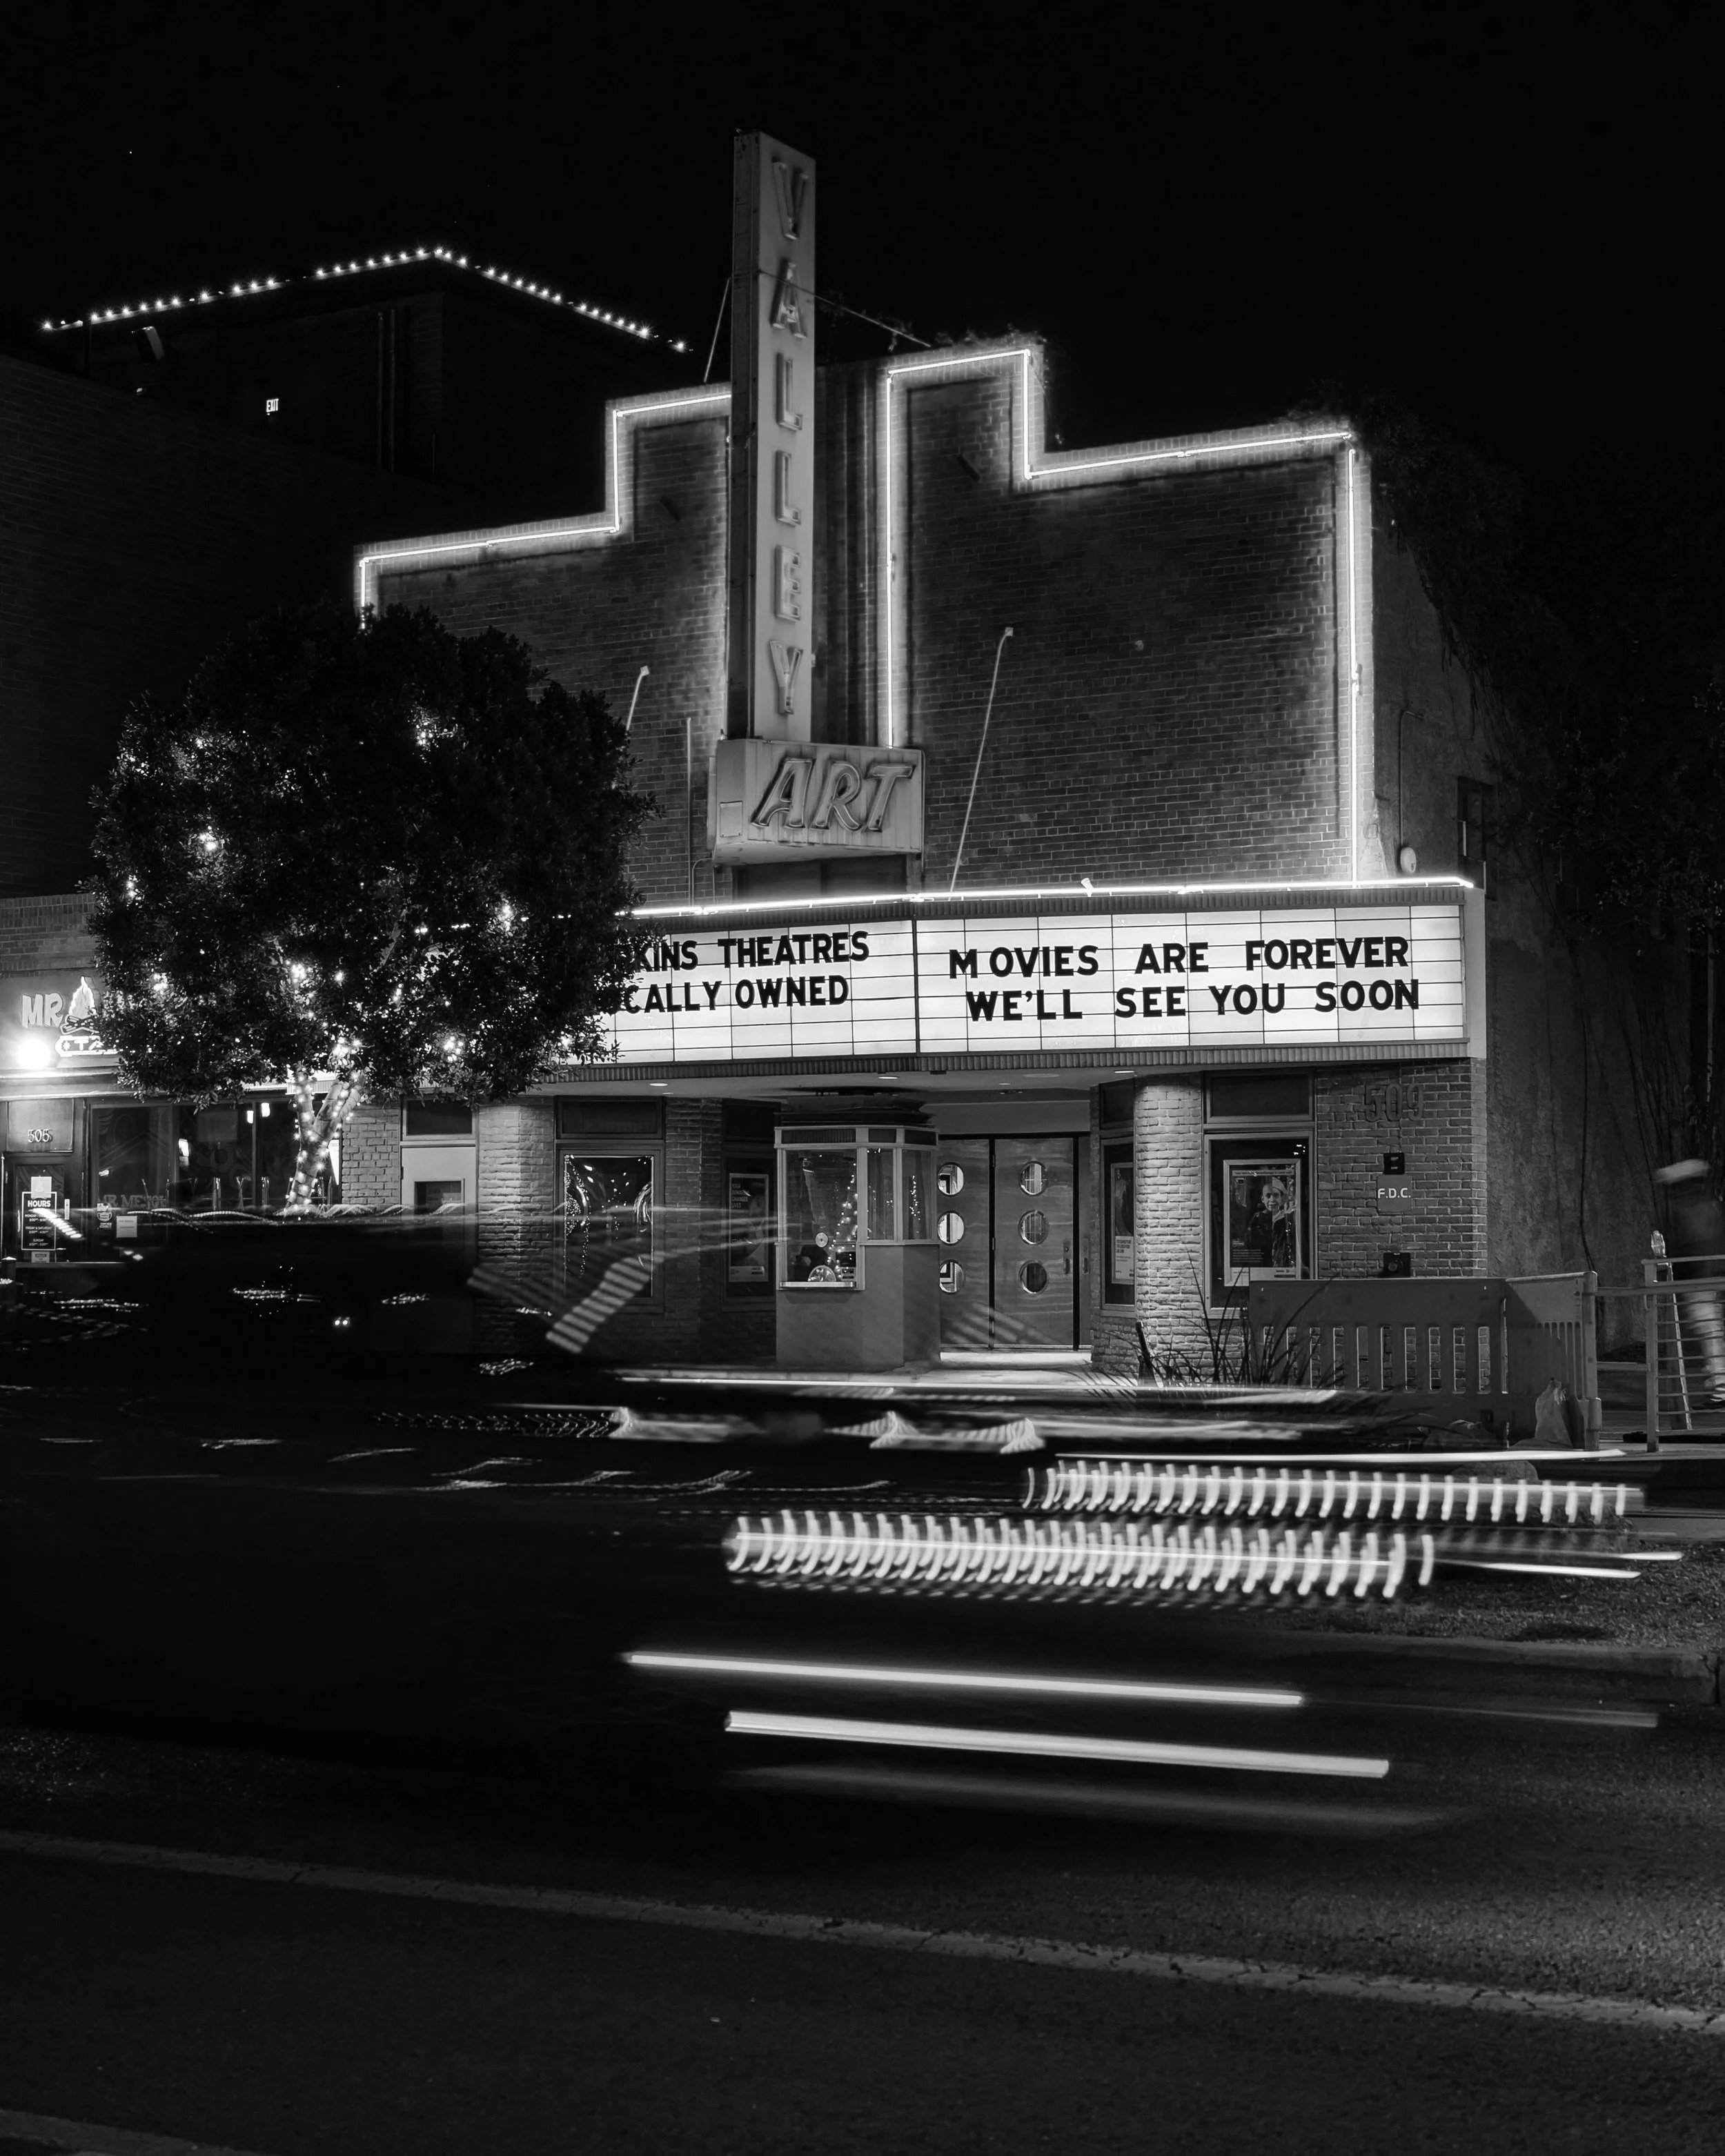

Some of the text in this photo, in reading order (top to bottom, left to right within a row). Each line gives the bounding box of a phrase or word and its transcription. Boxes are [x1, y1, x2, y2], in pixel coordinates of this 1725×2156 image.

[266, 398, 279, 413] EXIT
[770, 159, 809, 715] VALLEY
[751, 758, 916, 832] ART
[633, 931, 870, 973] KINS THEATRES
[1134, 942, 1210, 975] ARE
[1245, 936, 1409, 971] FOREVER
[21, 992, 64, 1029] MR
[625, 975, 849, 1014] CALLY OWNED
[965, 979, 1419, 1022] WE'LL SEE YOU SOON
[28, 1129, 52, 1143] 505
[1377, 1187, 1411, 1198] F.D.C.
